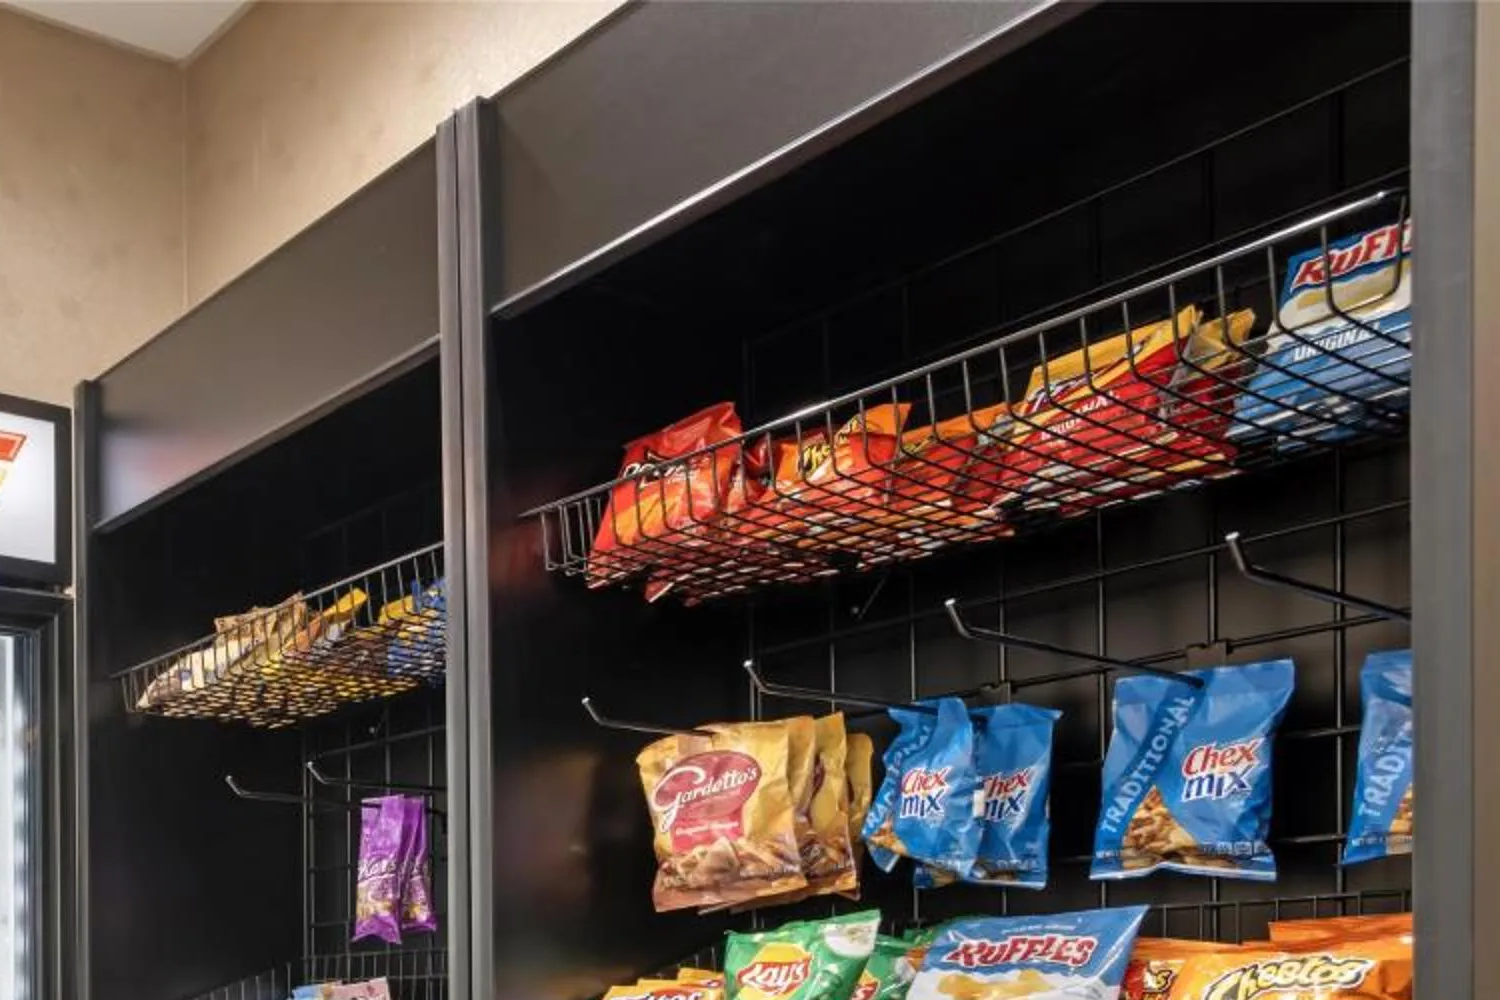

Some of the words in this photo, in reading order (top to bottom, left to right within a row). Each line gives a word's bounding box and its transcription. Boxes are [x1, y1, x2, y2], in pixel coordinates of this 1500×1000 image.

[1102, 694, 1195, 833] TRADITIONAL
[1183, 736, 1264, 778] Chex
[900, 766, 953, 795] Chex
[983, 769, 1034, 798] hex
[1182, 766, 1262, 802] mix
[651, 765, 758, 833] Gardetto's
[943, 934, 1099, 968] RUFFLES
